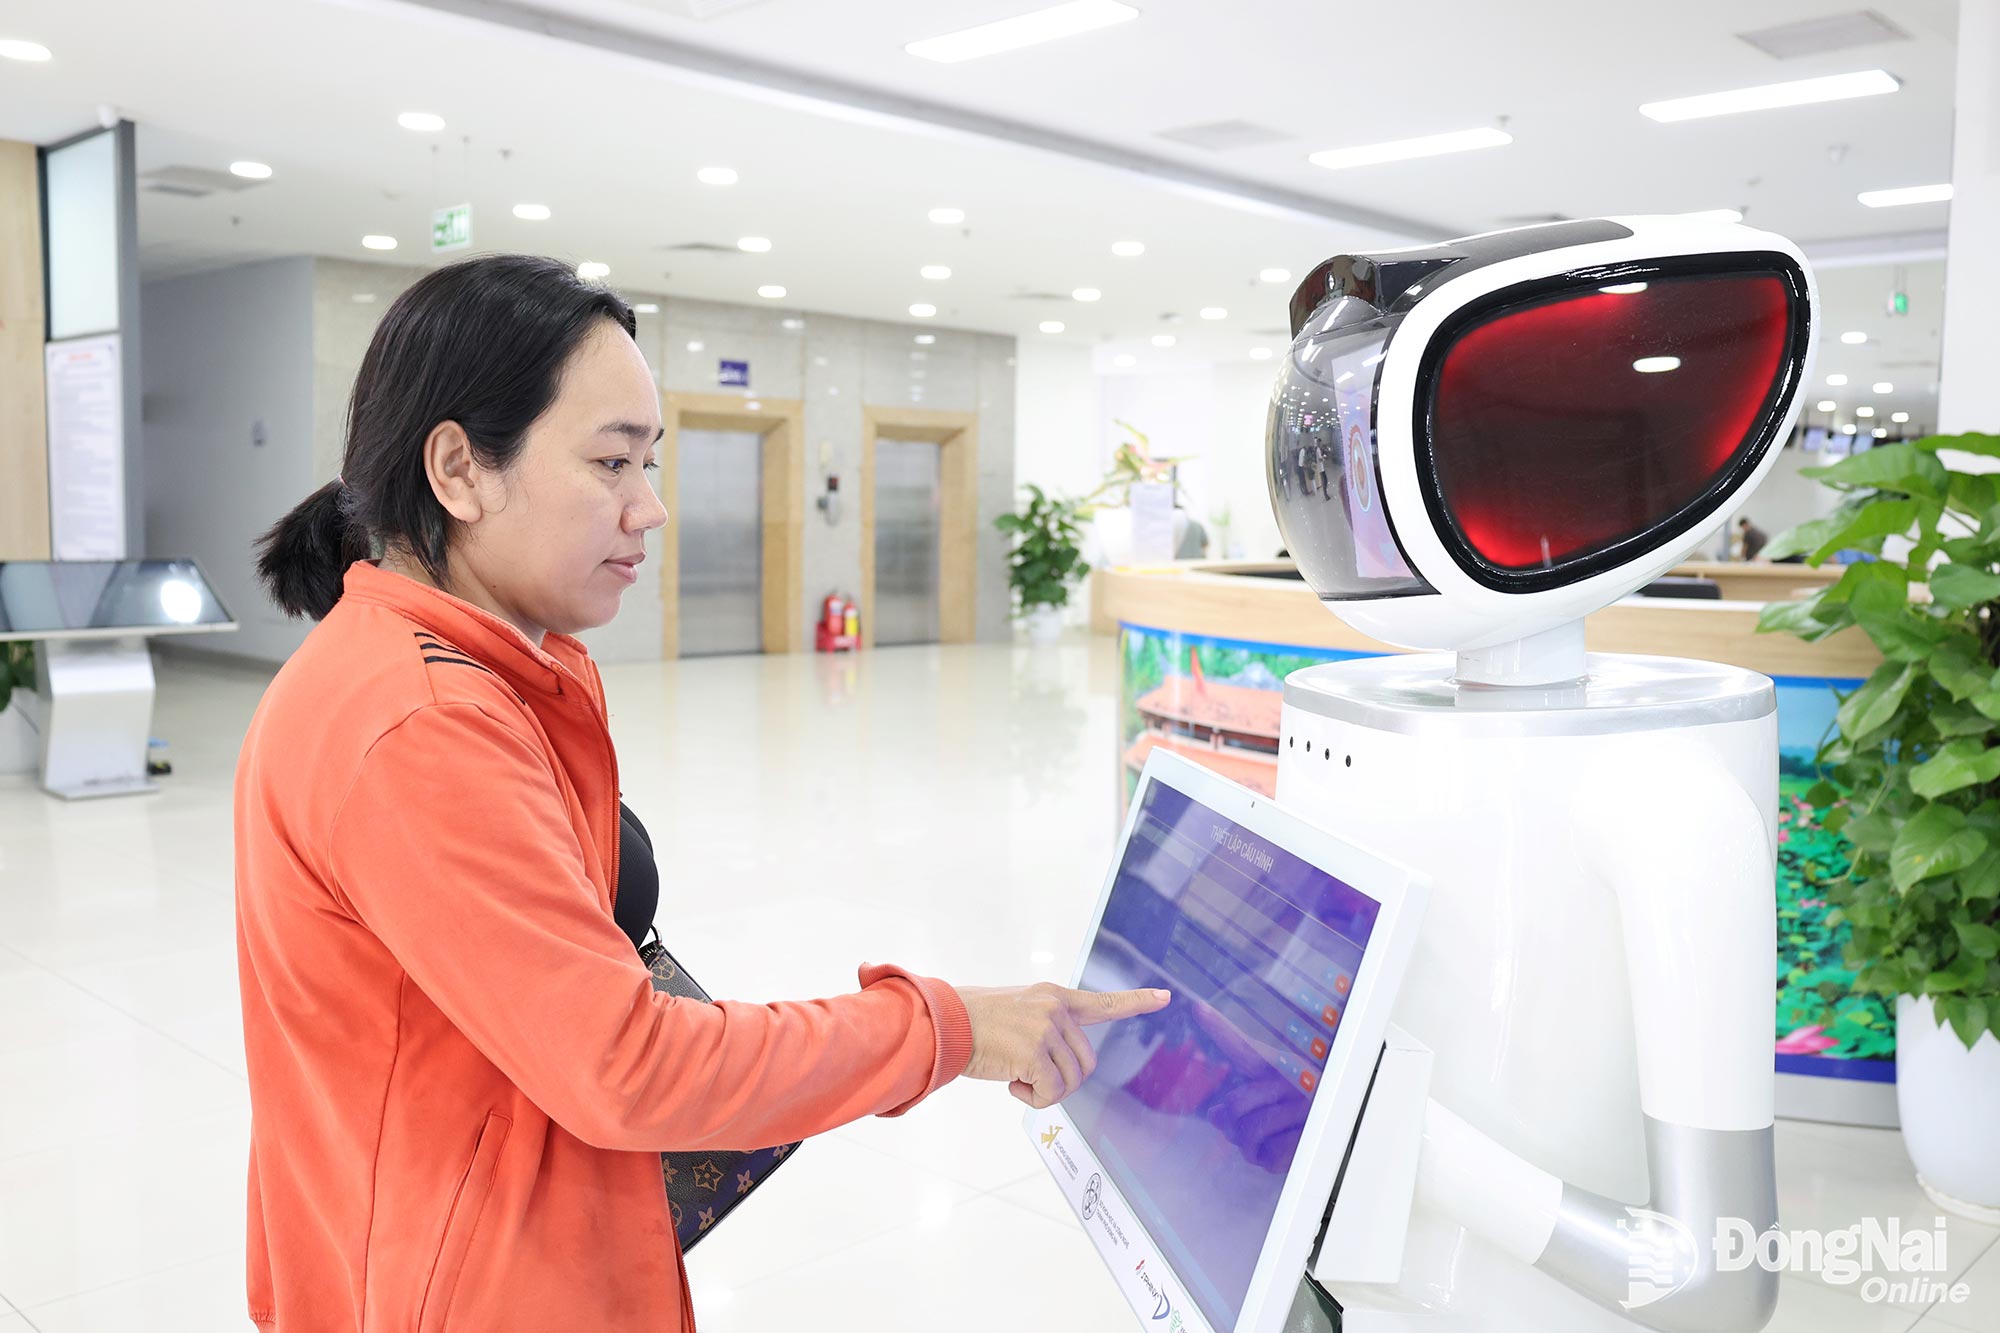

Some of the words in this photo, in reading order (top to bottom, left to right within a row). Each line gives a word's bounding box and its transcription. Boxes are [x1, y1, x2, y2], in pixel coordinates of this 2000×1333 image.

[1211, 824, 1230, 846] THIẾT
[1227, 833, 1242, 854] LẬP
[1241, 842, 1257, 863] CẤU
[1253, 849, 1274, 873] HÌNH
